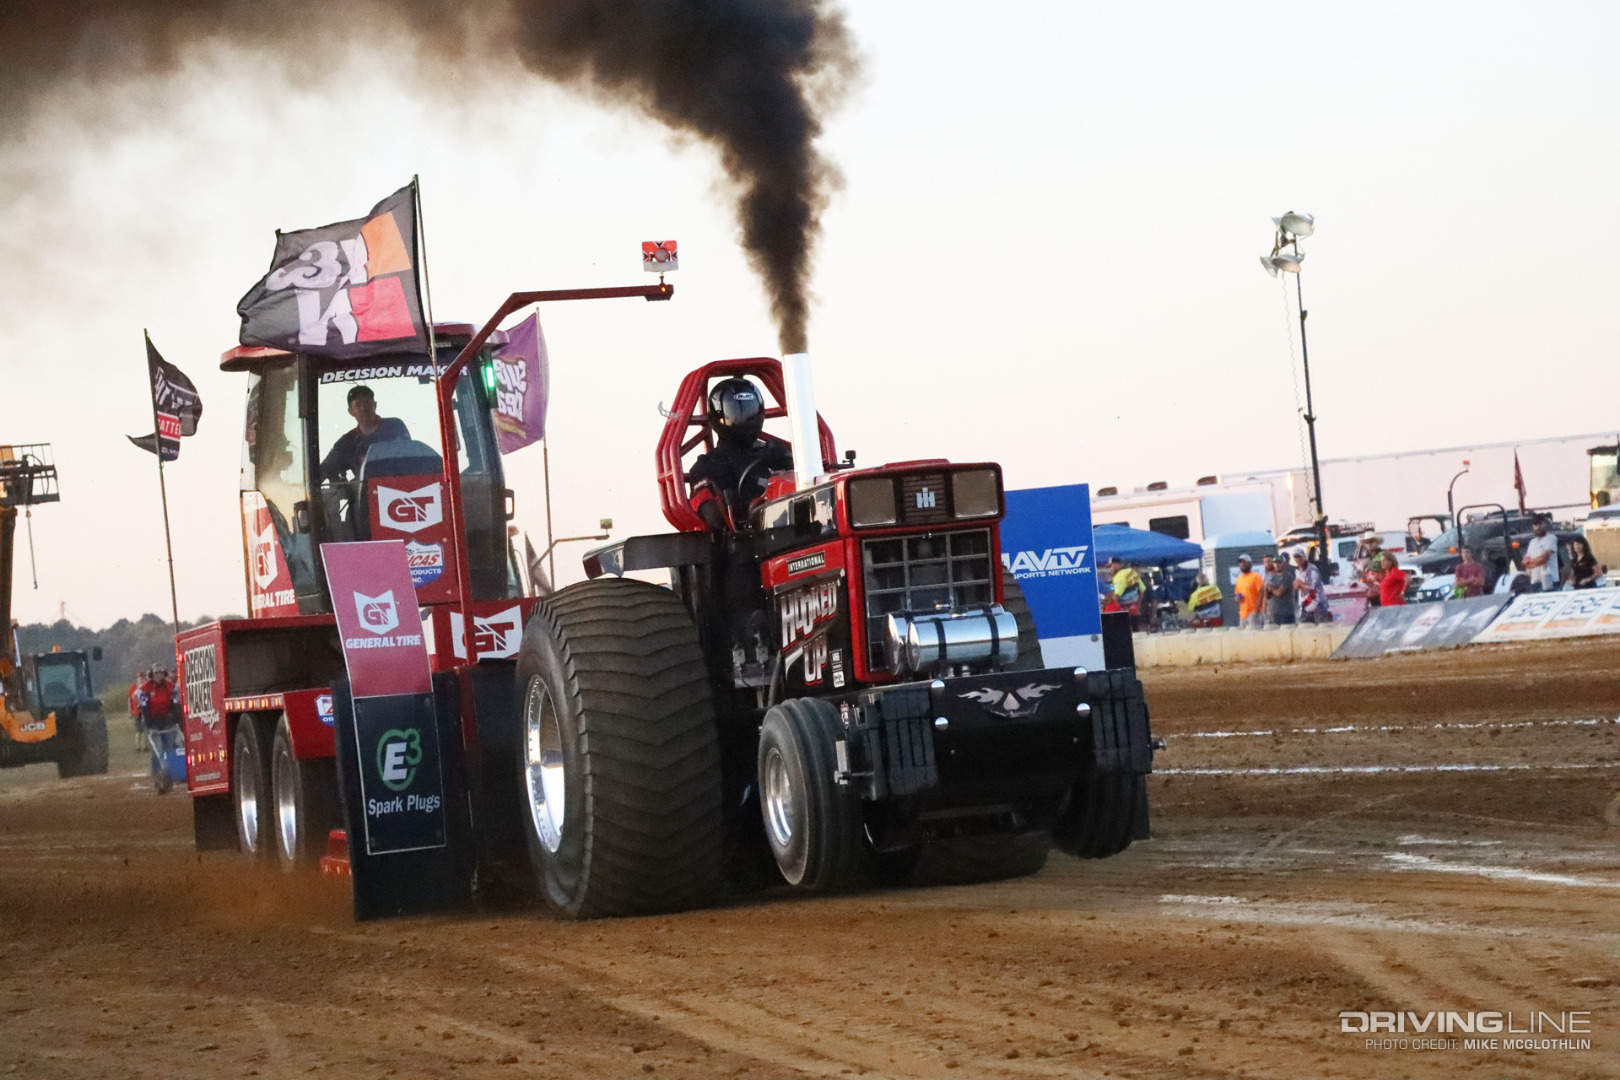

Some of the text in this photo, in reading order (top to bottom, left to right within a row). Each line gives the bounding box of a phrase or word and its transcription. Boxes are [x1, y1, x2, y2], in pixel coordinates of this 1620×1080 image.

[322, 365, 468, 384] DECISION MAKR
[158, 419, 180, 436] ATTE
[788, 555, 825, 573] INTERNATIONAL
[1048, 567, 1091, 576] NETWORK
[275, 589, 296, 606] TIRE
[781, 581, 837, 649] HOOKED
[346, 634, 421, 650] GENERAL TIRE
[185, 644, 216, 687] DECISION
[803, 635, 828, 683] UP
[188, 679, 214, 719] MAKER
[21, 722, 46, 731] JCB
[368, 794, 441, 818] Spark Plugs
